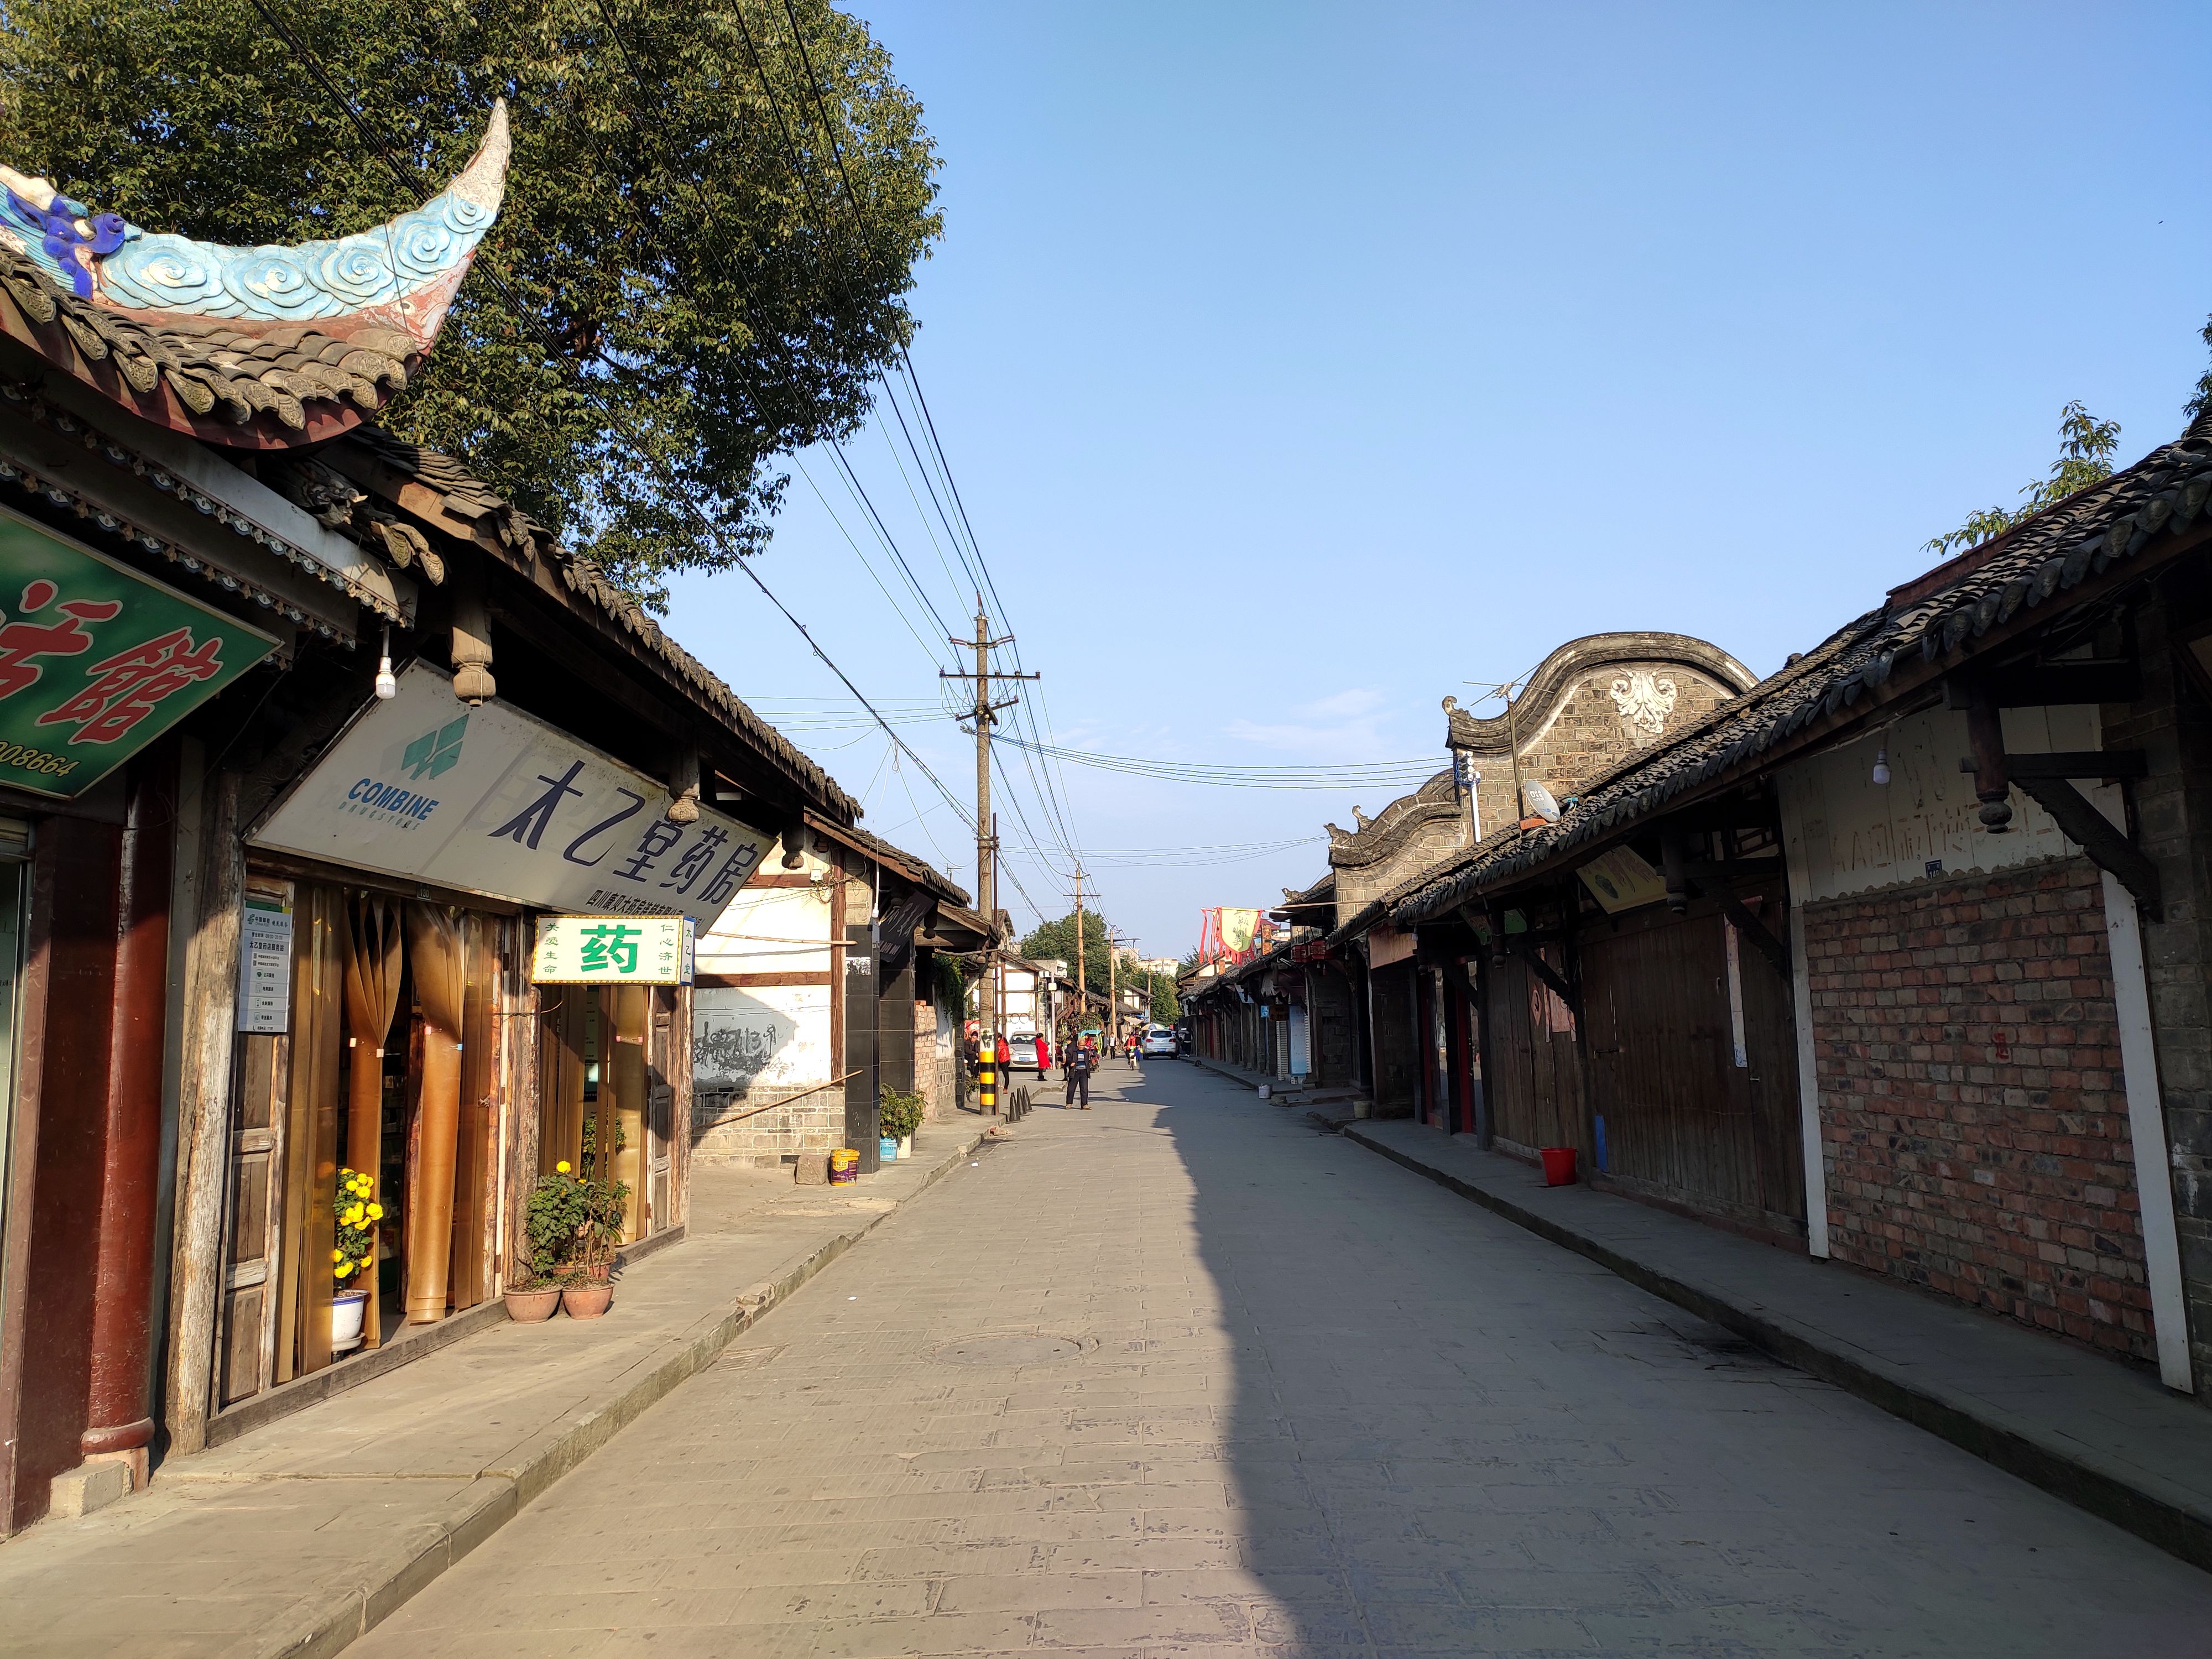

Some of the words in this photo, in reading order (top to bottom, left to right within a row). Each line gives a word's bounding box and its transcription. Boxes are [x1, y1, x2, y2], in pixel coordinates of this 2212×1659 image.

[338, 801, 421, 830] DRUGSTORE
[348, 778, 440, 821] COMBINE
[487, 759, 759, 905] 太乙堂药房
[249, 941, 284, 952] 太乙堂药店服务站
[542, 922, 560, 974] 关爱生命
[580, 924, 642, 974] 药
[658, 924, 675, 974] 仁心济世
[683, 927, 692, 975] 太乙堂
